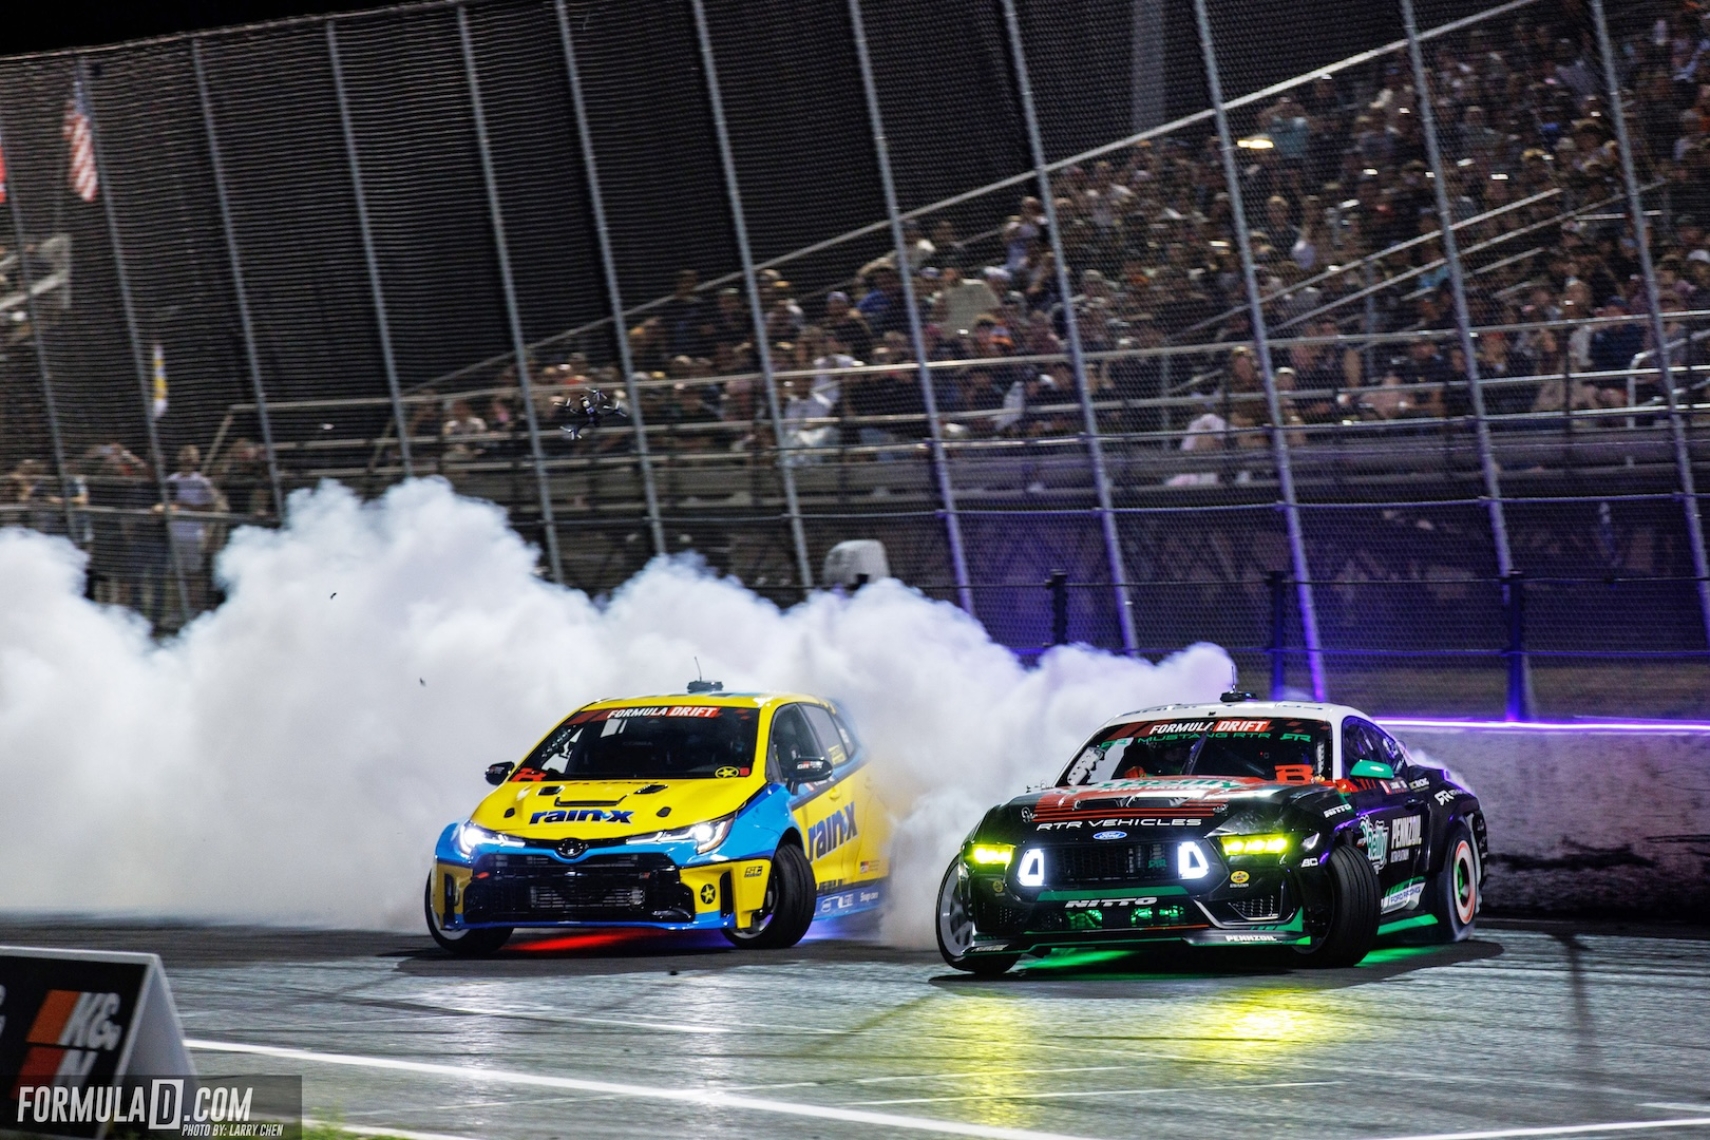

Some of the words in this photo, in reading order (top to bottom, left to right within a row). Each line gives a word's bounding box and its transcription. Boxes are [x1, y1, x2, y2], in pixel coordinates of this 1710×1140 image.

[607, 707, 669, 719] FORMULA
[668, 707, 717, 717] DRIFT
[1217, 721, 1267, 732] DRIFT
[1137, 733, 1229, 743] MUSTANG
[1323, 804, 1352, 818] NITTO
[1036, 821, 1083, 832] RTR
[1088, 818, 1202, 828] VEHICLES
[1065, 897, 1157, 909] NITTO
